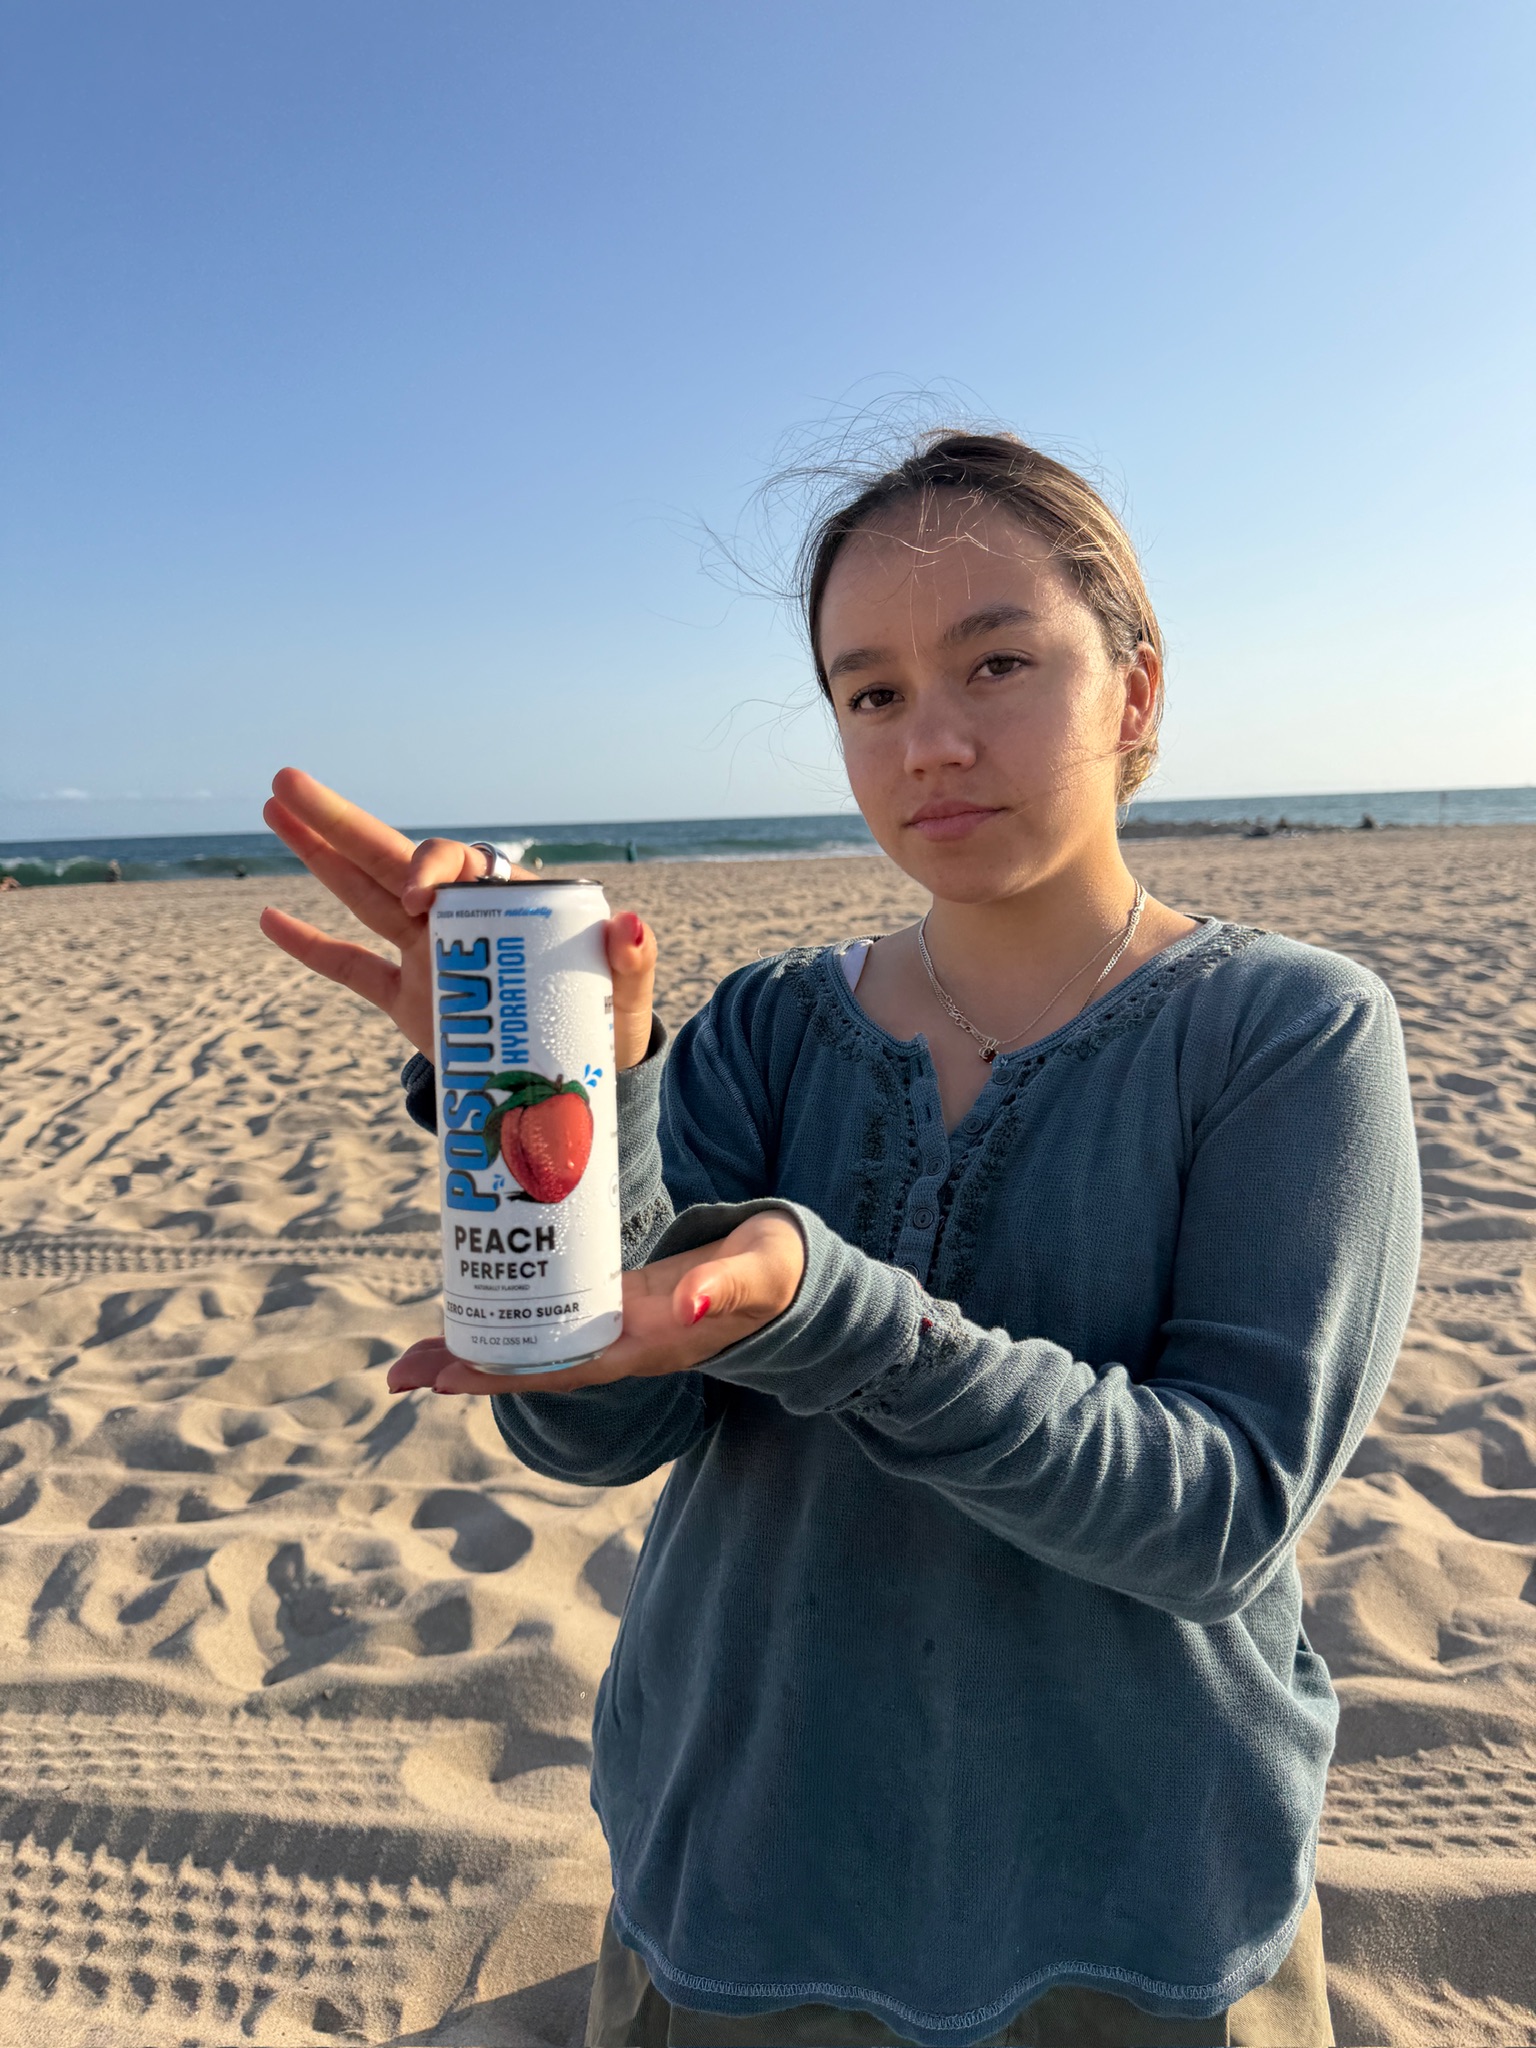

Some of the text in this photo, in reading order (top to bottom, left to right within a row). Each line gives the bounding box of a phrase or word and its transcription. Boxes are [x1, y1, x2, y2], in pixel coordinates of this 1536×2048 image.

[455, 908, 503, 919] NEGATIVITY
[497, 936, 529, 1065] HYDRATION
[436, 936, 501, 1212] POSITIVE
[454, 1224, 556, 1254] PEACH
[460, 1260, 549, 1280] PERFECT
[446, 1300, 580, 1320] ZERO CAL ZERO SUGAR
[471, 1335, 479, 1344] 12
[480, 1336, 489, 1346] FL
[489, 1336, 501, 1346] OZ
[522, 1335, 538, 1346] ML)
